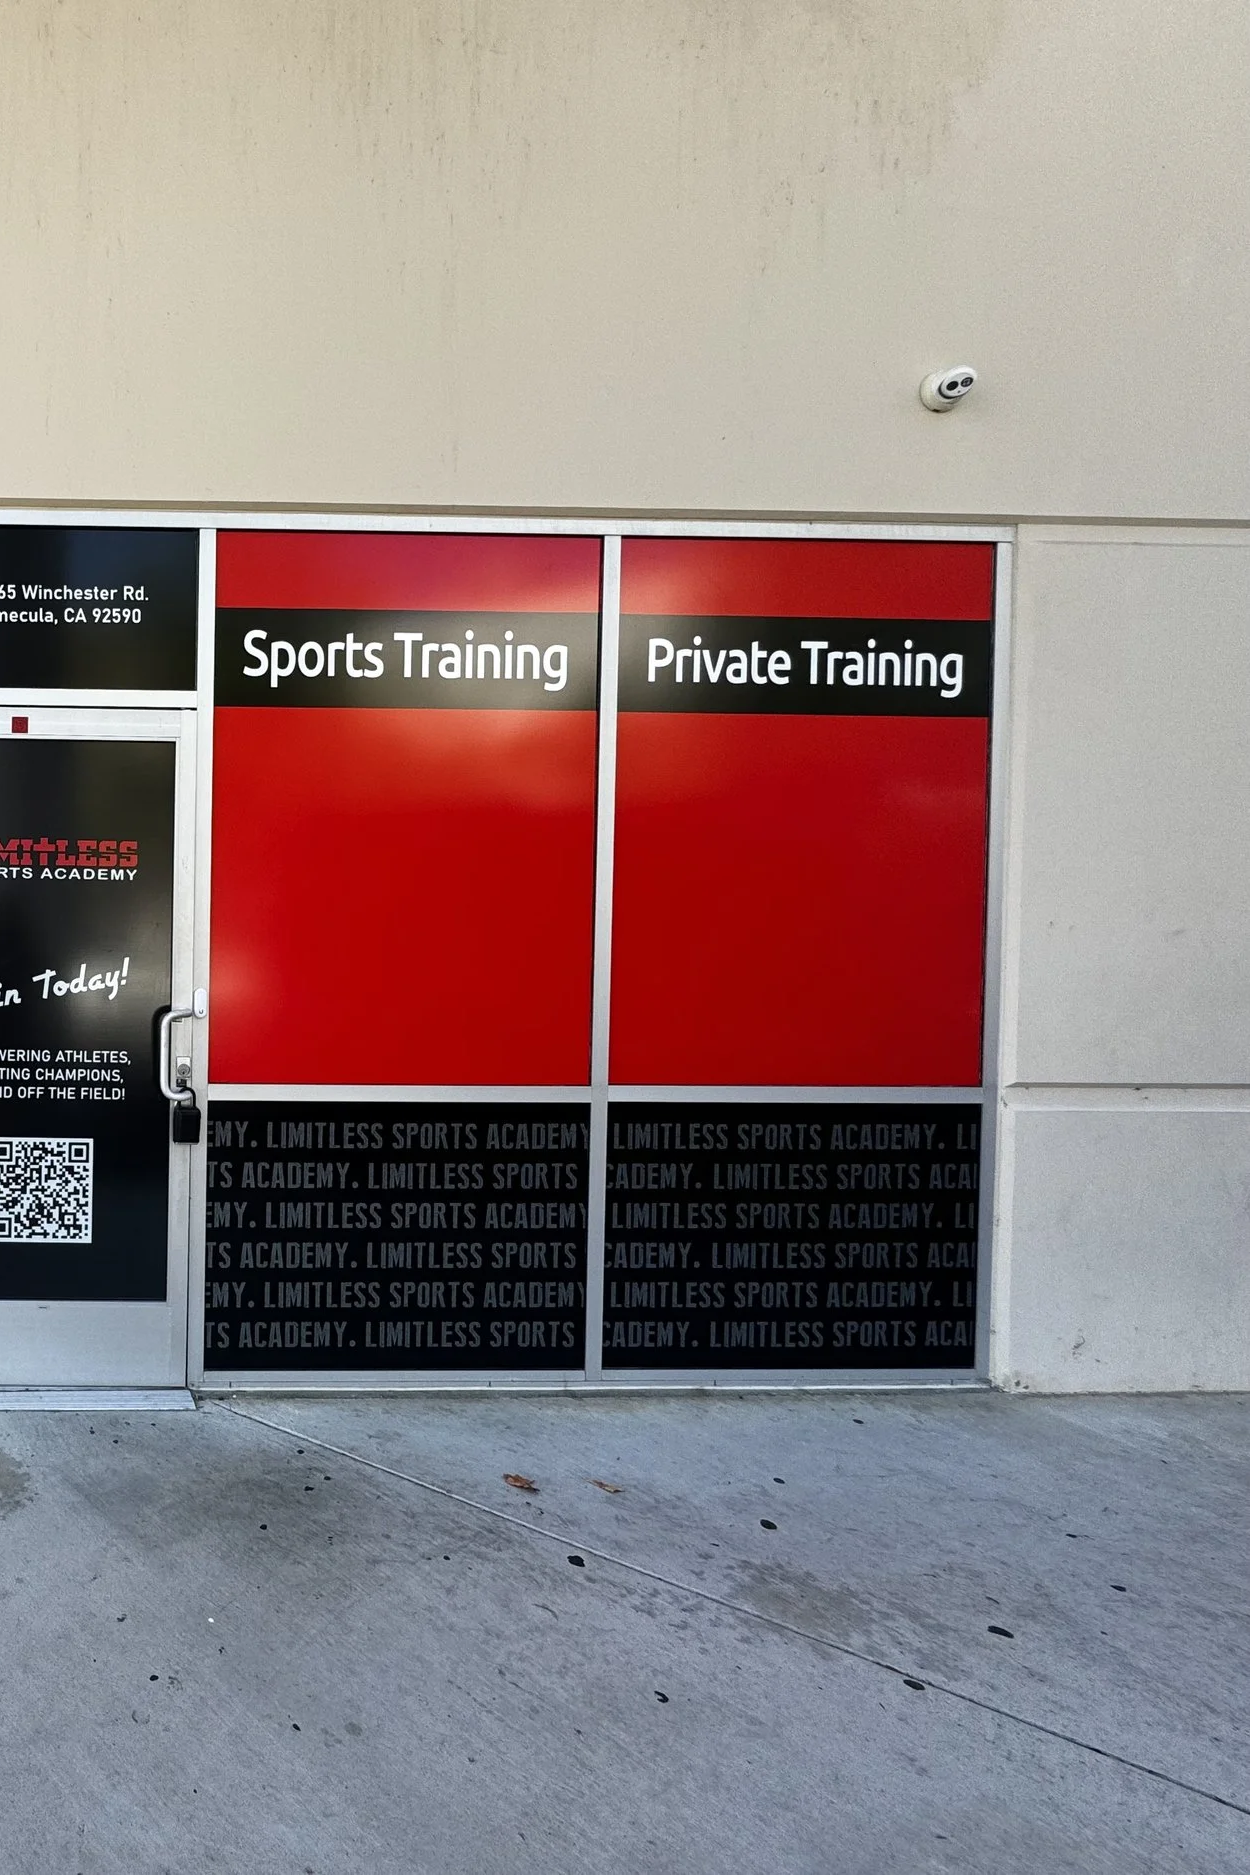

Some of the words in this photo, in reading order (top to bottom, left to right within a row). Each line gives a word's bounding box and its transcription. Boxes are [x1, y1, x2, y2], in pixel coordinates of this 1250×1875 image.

[22, 585, 118, 601] Winchester
[123, 586, 149, 601] Rd.
[63, 609, 86, 623] CA
[92, 608, 141, 624] 92590
[243, 629, 384, 688] Sports
[393, 629, 568, 692] Training
[647, 635, 792, 685] Private
[800, 638, 963, 698] Training
[40, 868, 138, 881] ACADEMY
[32, 957, 130, 1001] Today!
[55, 1050, 132, 1066] ATHLETES,
[35, 1068, 124, 1083] CHAMPIONS,
[17, 1086, 45, 1099] OFF
[49, 1087, 76, 1099] THE
[80, 1087, 126, 1100] FIELD!
[267, 1122, 383, 1148] LIMITLESS
[393, 1123, 477, 1149] SPORTS
[614, 1123, 728, 1149] LIMITLESS
[738, 1124, 821, 1149] SPORTS
[831, 1124, 944, 1149] ACADEMY.
[242, 1162, 358, 1188] ACADEMY.
[368, 1163, 483, 1189] LIMITLESS
[493, 1163, 577, 1189] SPORTS
[714, 1164, 827, 1190] LIMITLESS
[837, 1164, 920, 1189] SPORTS
[266, 1202, 381, 1228] LIMITLESS
[391, 1203, 475, 1228] SPORTS
[612, 1203, 726, 1229] LIMITLESS
[736, 1203, 819, 1228] SPORTS
[829, 1203, 942, 1228] ACADEMY.
[240, 1242, 357, 1268] ACADEMY.
[367, 1242, 482, 1268] LIMITLESS
[492, 1243, 576, 1268] SPORTS
[712, 1243, 825, 1269] LIMITLESS
[835, 1243, 918, 1268] SPORTS
[265, 1282, 380, 1308] LIMITLESS
[390, 1282, 474, 1308] SPORTS
[611, 1282, 725, 1308] LIMITLESS
[734, 1282, 817, 1308] SPORTS
[827, 1282, 940, 1307] ACADEMY.
[239, 1322, 355, 1347] ACADEMY.
[366, 1322, 480, 1347] LIMITLESS
[490, 1322, 574, 1347] SPORTS
[710, 1322, 823, 1347] LIMITLESS
[833, 1321, 916, 1347] SPORTS
